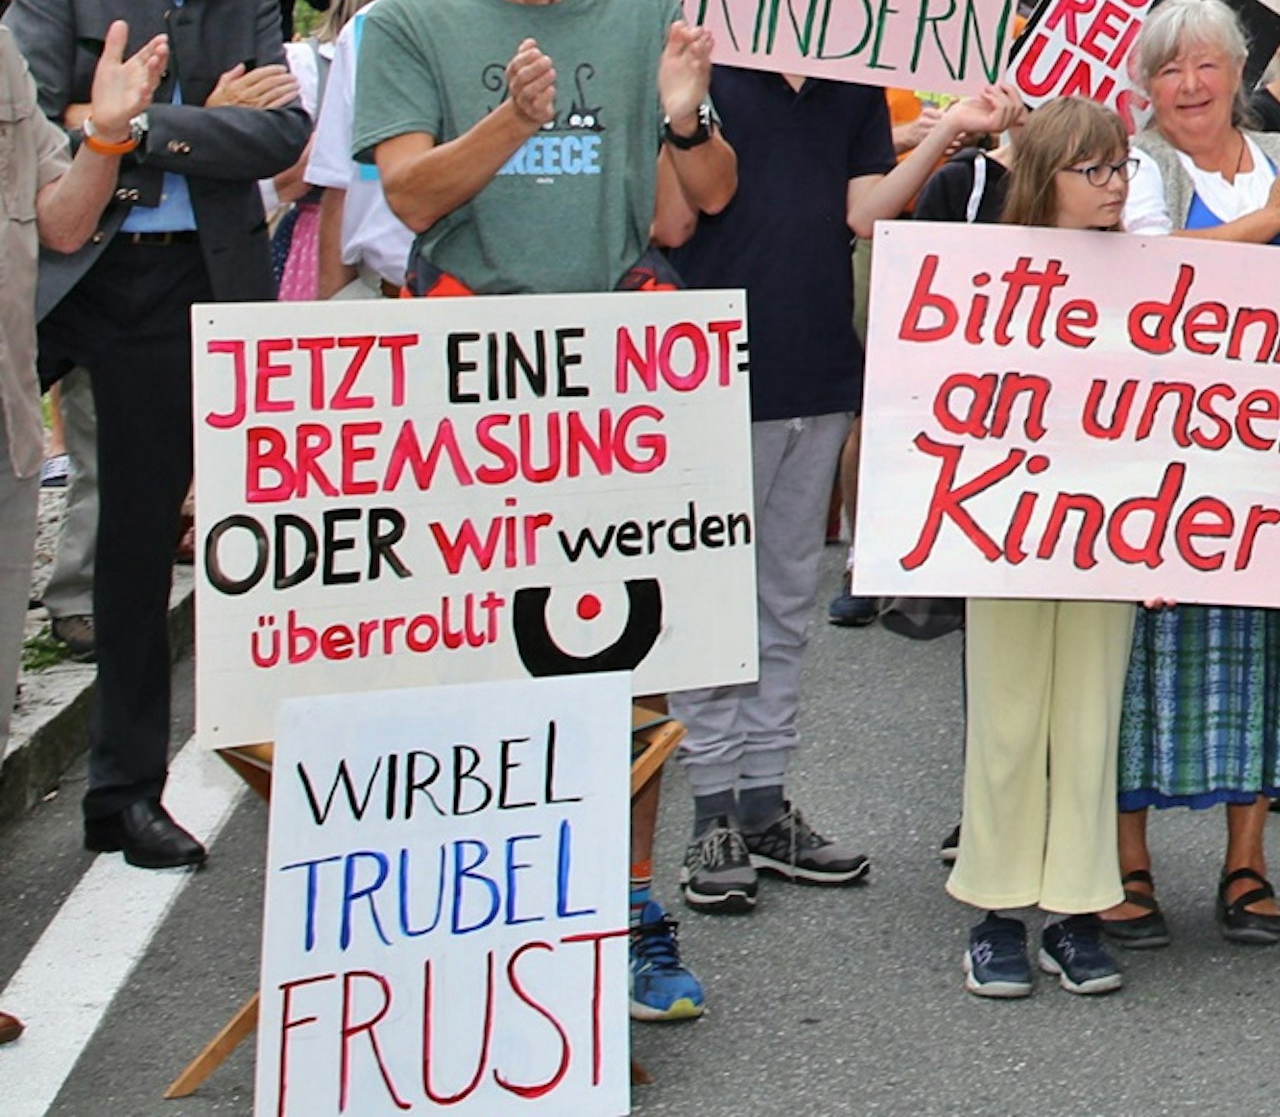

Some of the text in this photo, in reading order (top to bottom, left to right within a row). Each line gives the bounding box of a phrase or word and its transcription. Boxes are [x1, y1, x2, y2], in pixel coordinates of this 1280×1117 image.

[897, 254, 1100, 348] bitte
[205, 334, 419, 428] JETZT
[447, 328, 590, 403] EINE
[933, 372, 1053, 441] an
[244, 404, 667, 503] BREMSUNG
[203, 498, 751, 596] ODER wir werden
[250, 592, 505, 668] überrollt
[297, 720, 583, 826] WIRBEL
[279, 819, 597, 952] TRUBEL
[278, 929, 630, 1117] FRUST
